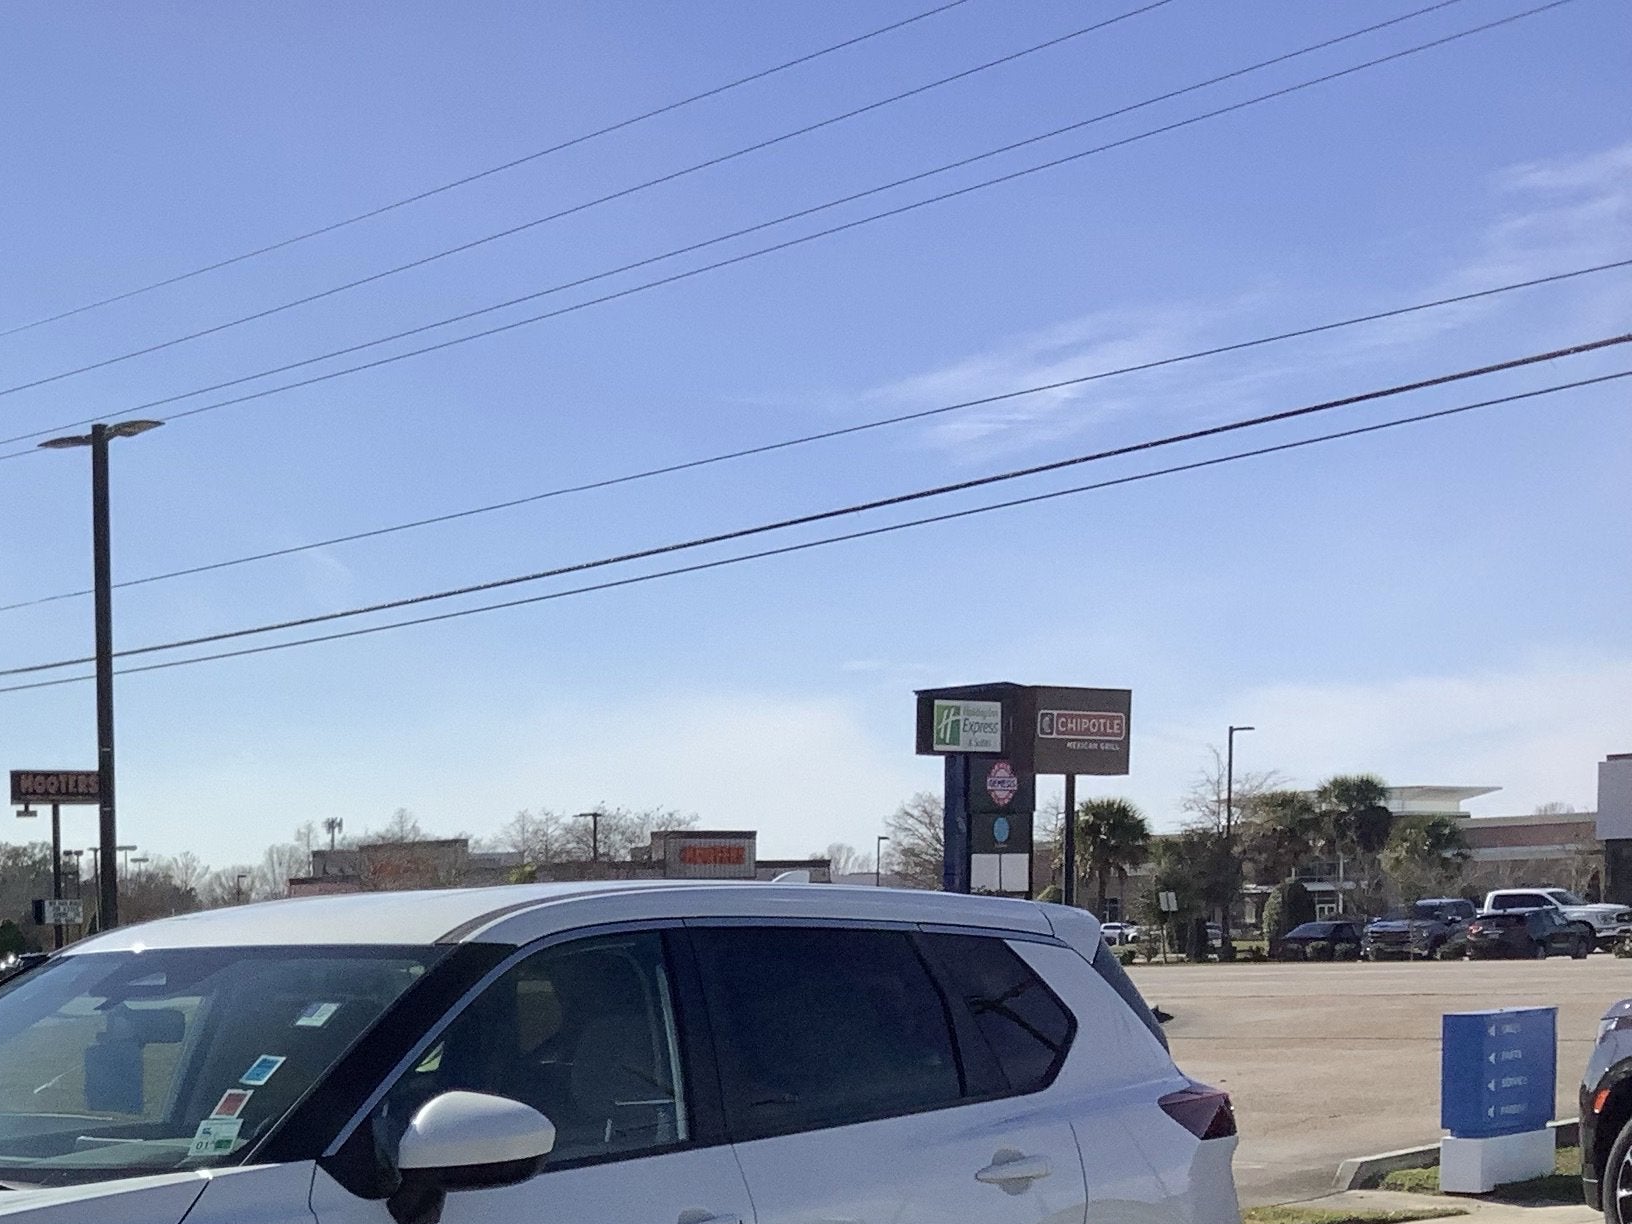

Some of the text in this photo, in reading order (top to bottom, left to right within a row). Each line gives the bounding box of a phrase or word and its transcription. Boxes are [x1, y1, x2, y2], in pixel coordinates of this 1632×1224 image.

[962, 718, 999, 735] Express
[1058, 717, 1121, 733] CHIPOTLE
[20, 774, 99, 794] HOOTERS
